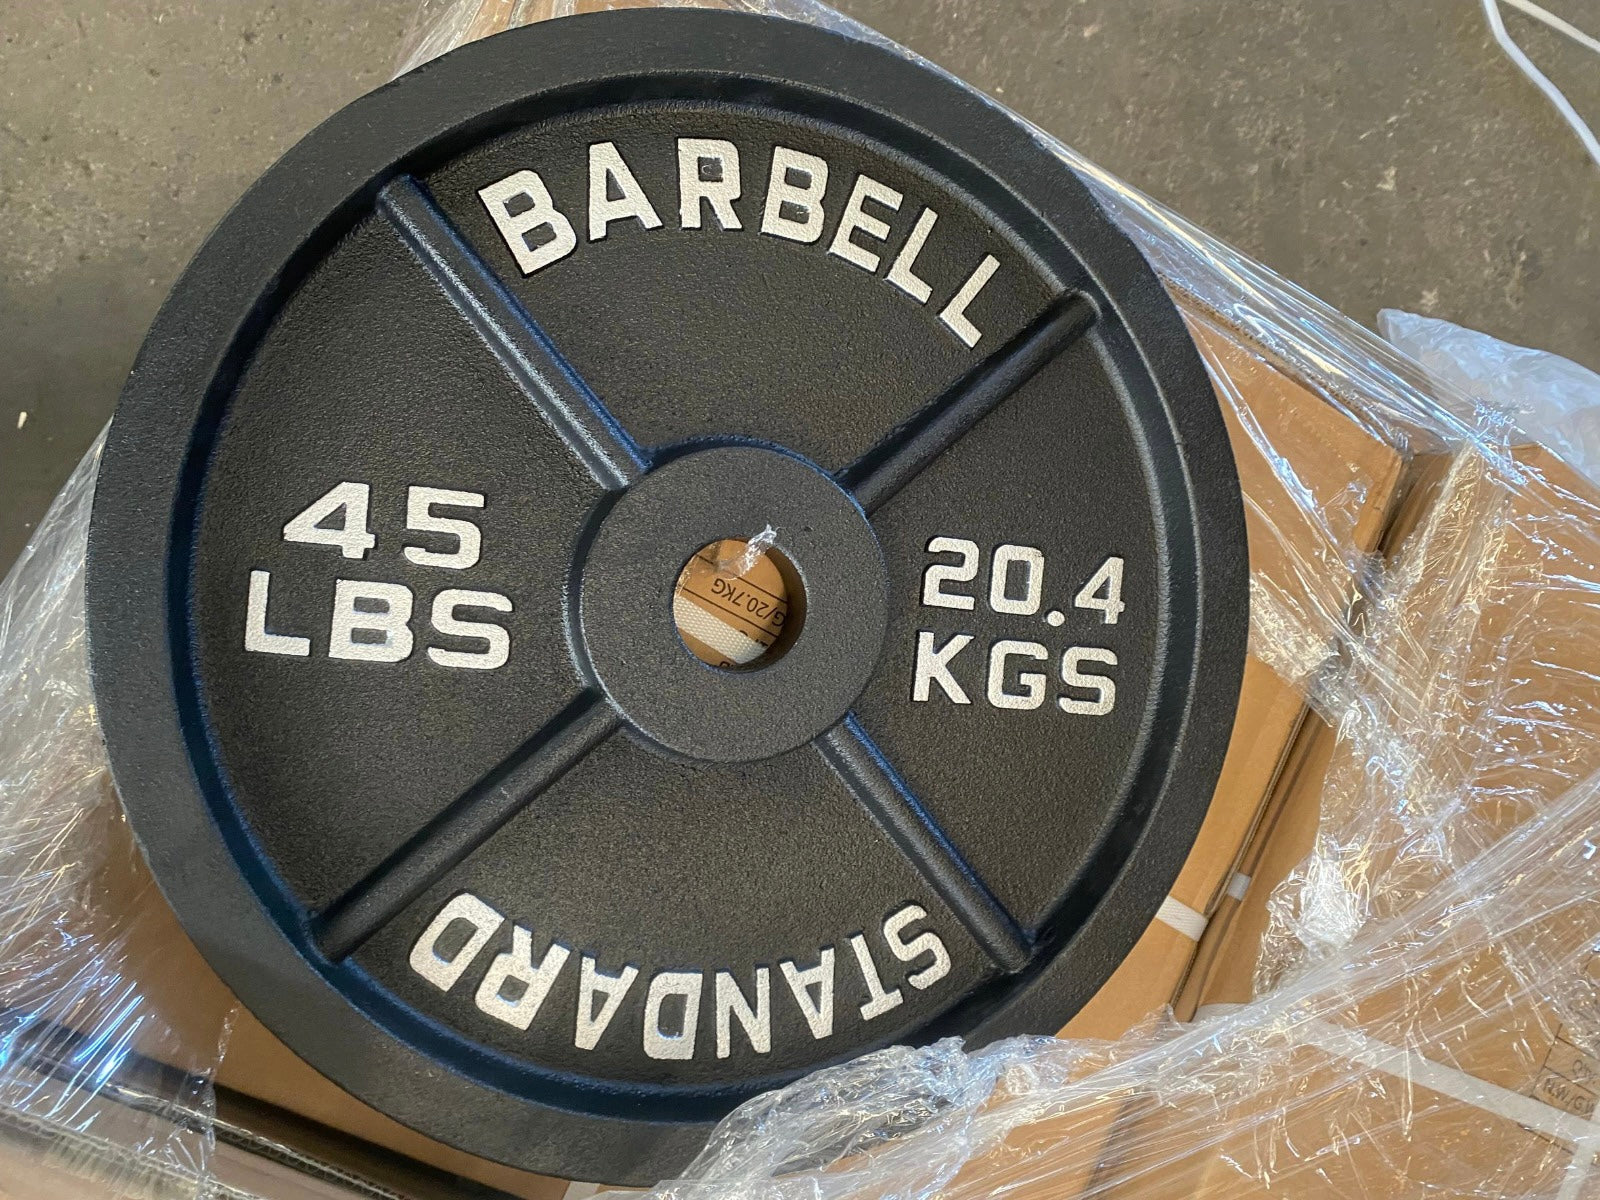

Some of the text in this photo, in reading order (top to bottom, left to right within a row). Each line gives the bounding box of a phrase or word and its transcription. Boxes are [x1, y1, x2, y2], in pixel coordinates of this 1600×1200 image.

[478, 138, 1000, 348] BARBELL
[283, 481, 485, 570] 45
[244, 571, 513, 670] LBS
[922, 536, 1126, 627] 20.4
[913, 631, 1120, 716] KGS
[408, 892, 952, 1060] STANDARD
